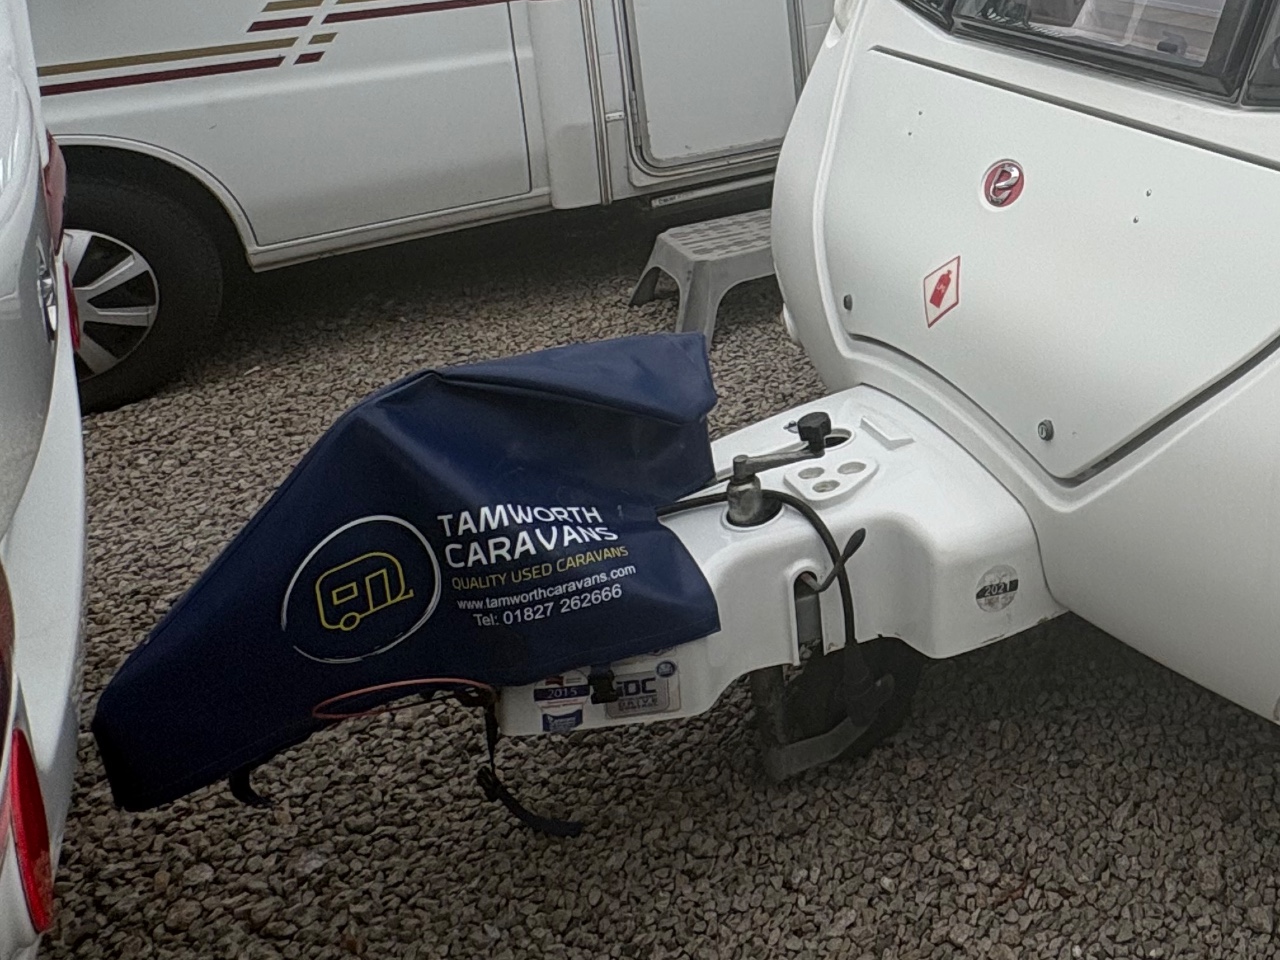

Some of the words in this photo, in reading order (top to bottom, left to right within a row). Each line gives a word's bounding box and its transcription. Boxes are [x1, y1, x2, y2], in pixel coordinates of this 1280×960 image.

[437, 503, 604, 538] TAMWORTH
[444, 525, 619, 570] CARAVANS
[452, 572, 508, 591] QUALITY
[511, 562, 553, 584] USED
[556, 545, 629, 573] CARAVANS
[457, 563, 637, 610] www.tamworthcaravans.com
[473, 613, 499, 627] Tel:
[502, 603, 555, 625] 01827
[559, 584, 623, 614] 262666
[984, 581, 1010, 596] 2021
[547, 687, 578, 699] 2015
